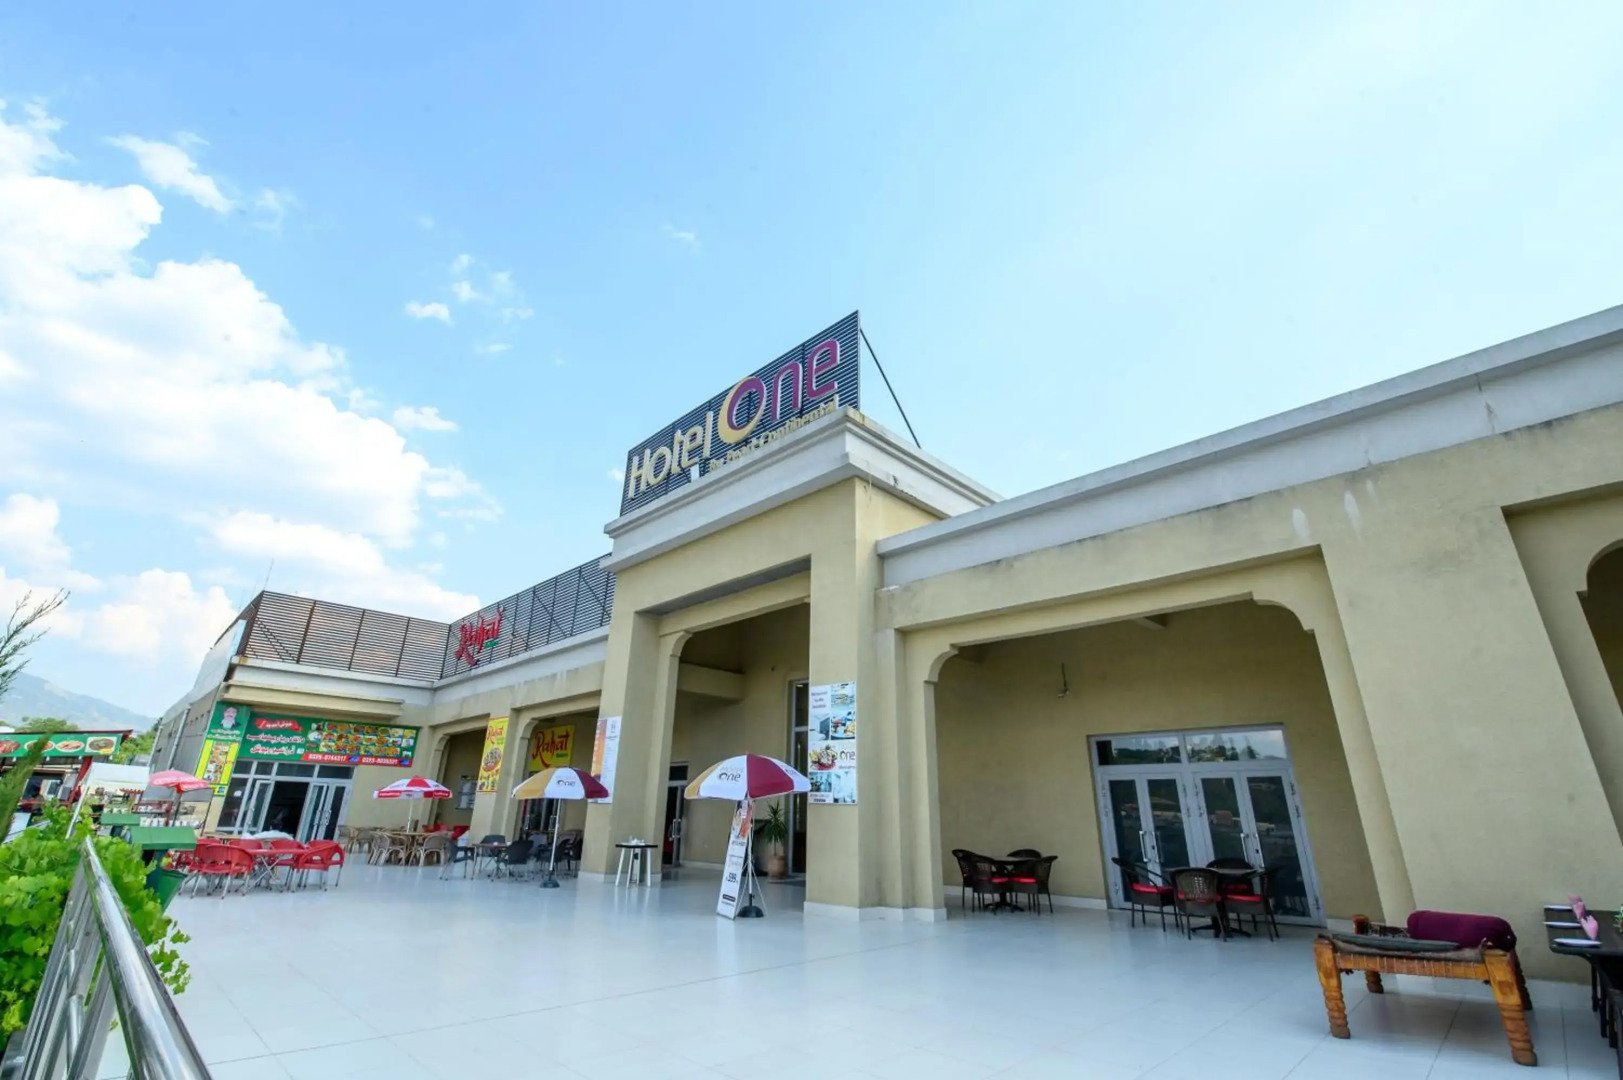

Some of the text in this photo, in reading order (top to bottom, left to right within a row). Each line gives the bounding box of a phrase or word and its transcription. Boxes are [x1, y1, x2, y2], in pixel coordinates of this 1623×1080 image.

[628, 339, 840, 500] Hotel One
[532, 730, 570, 768] Rahat
[718, 772, 741, 782] One
